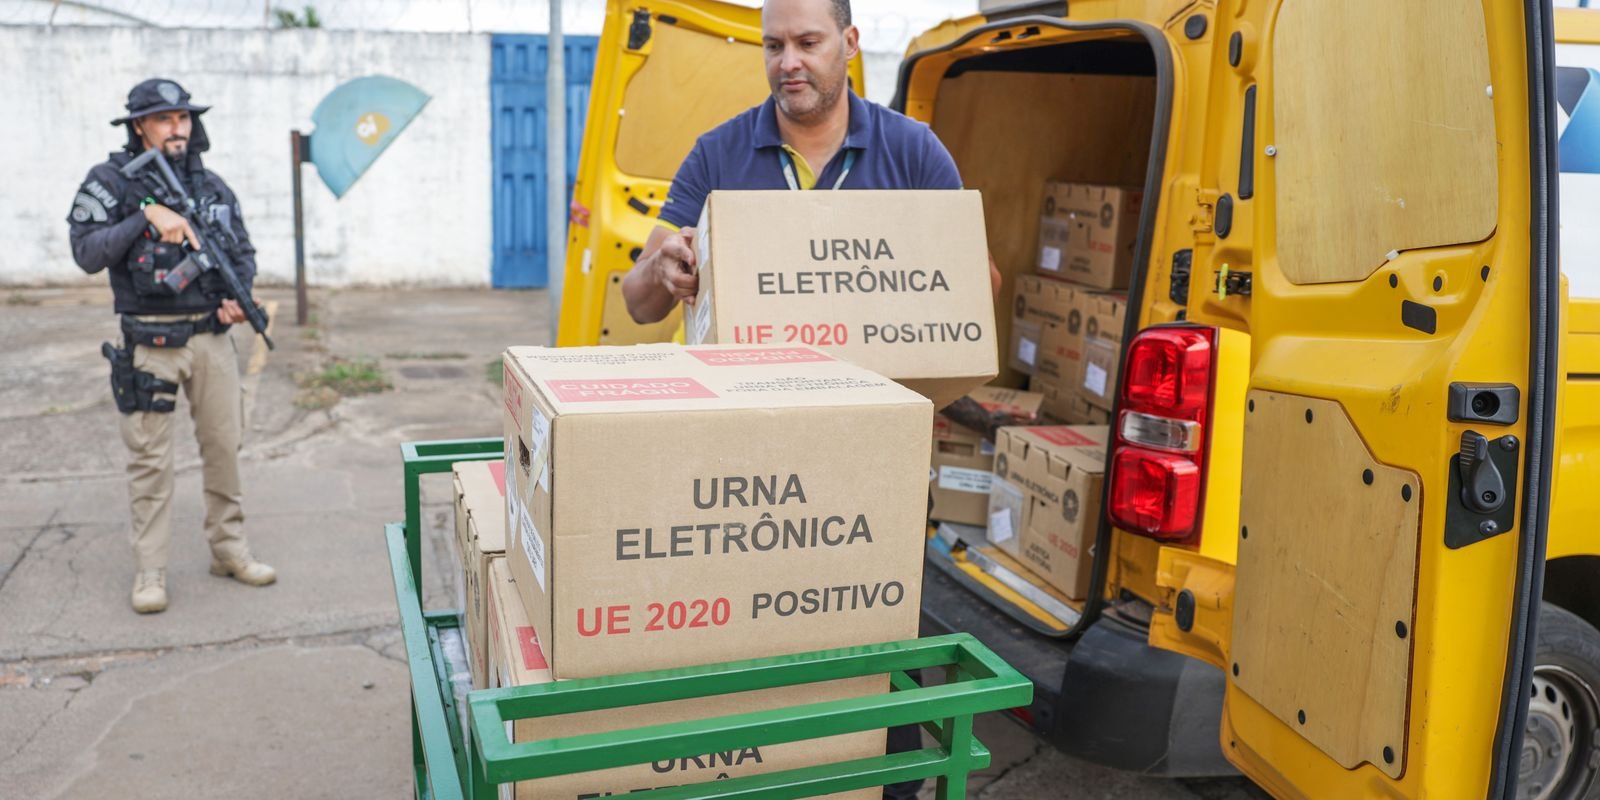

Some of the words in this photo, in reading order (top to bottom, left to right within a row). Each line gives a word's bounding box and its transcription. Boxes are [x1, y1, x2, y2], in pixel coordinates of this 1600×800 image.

[809, 238, 894, 261] URNA
[757, 265, 950, 295] ELETRÔNICA
[734, 325, 773, 345] UE
[783, 323, 848, 346] 2020
[863, 322, 982, 344] POSITIVO
[560, 382, 691, 391] CUIDADO
[693, 474, 807, 509] URNA
[616, 512, 873, 561] ELETRÔNICA
[577, 605, 630, 637] UE
[644, 597, 731, 632] 2020
[751, 581, 905, 619] POSITIVO
